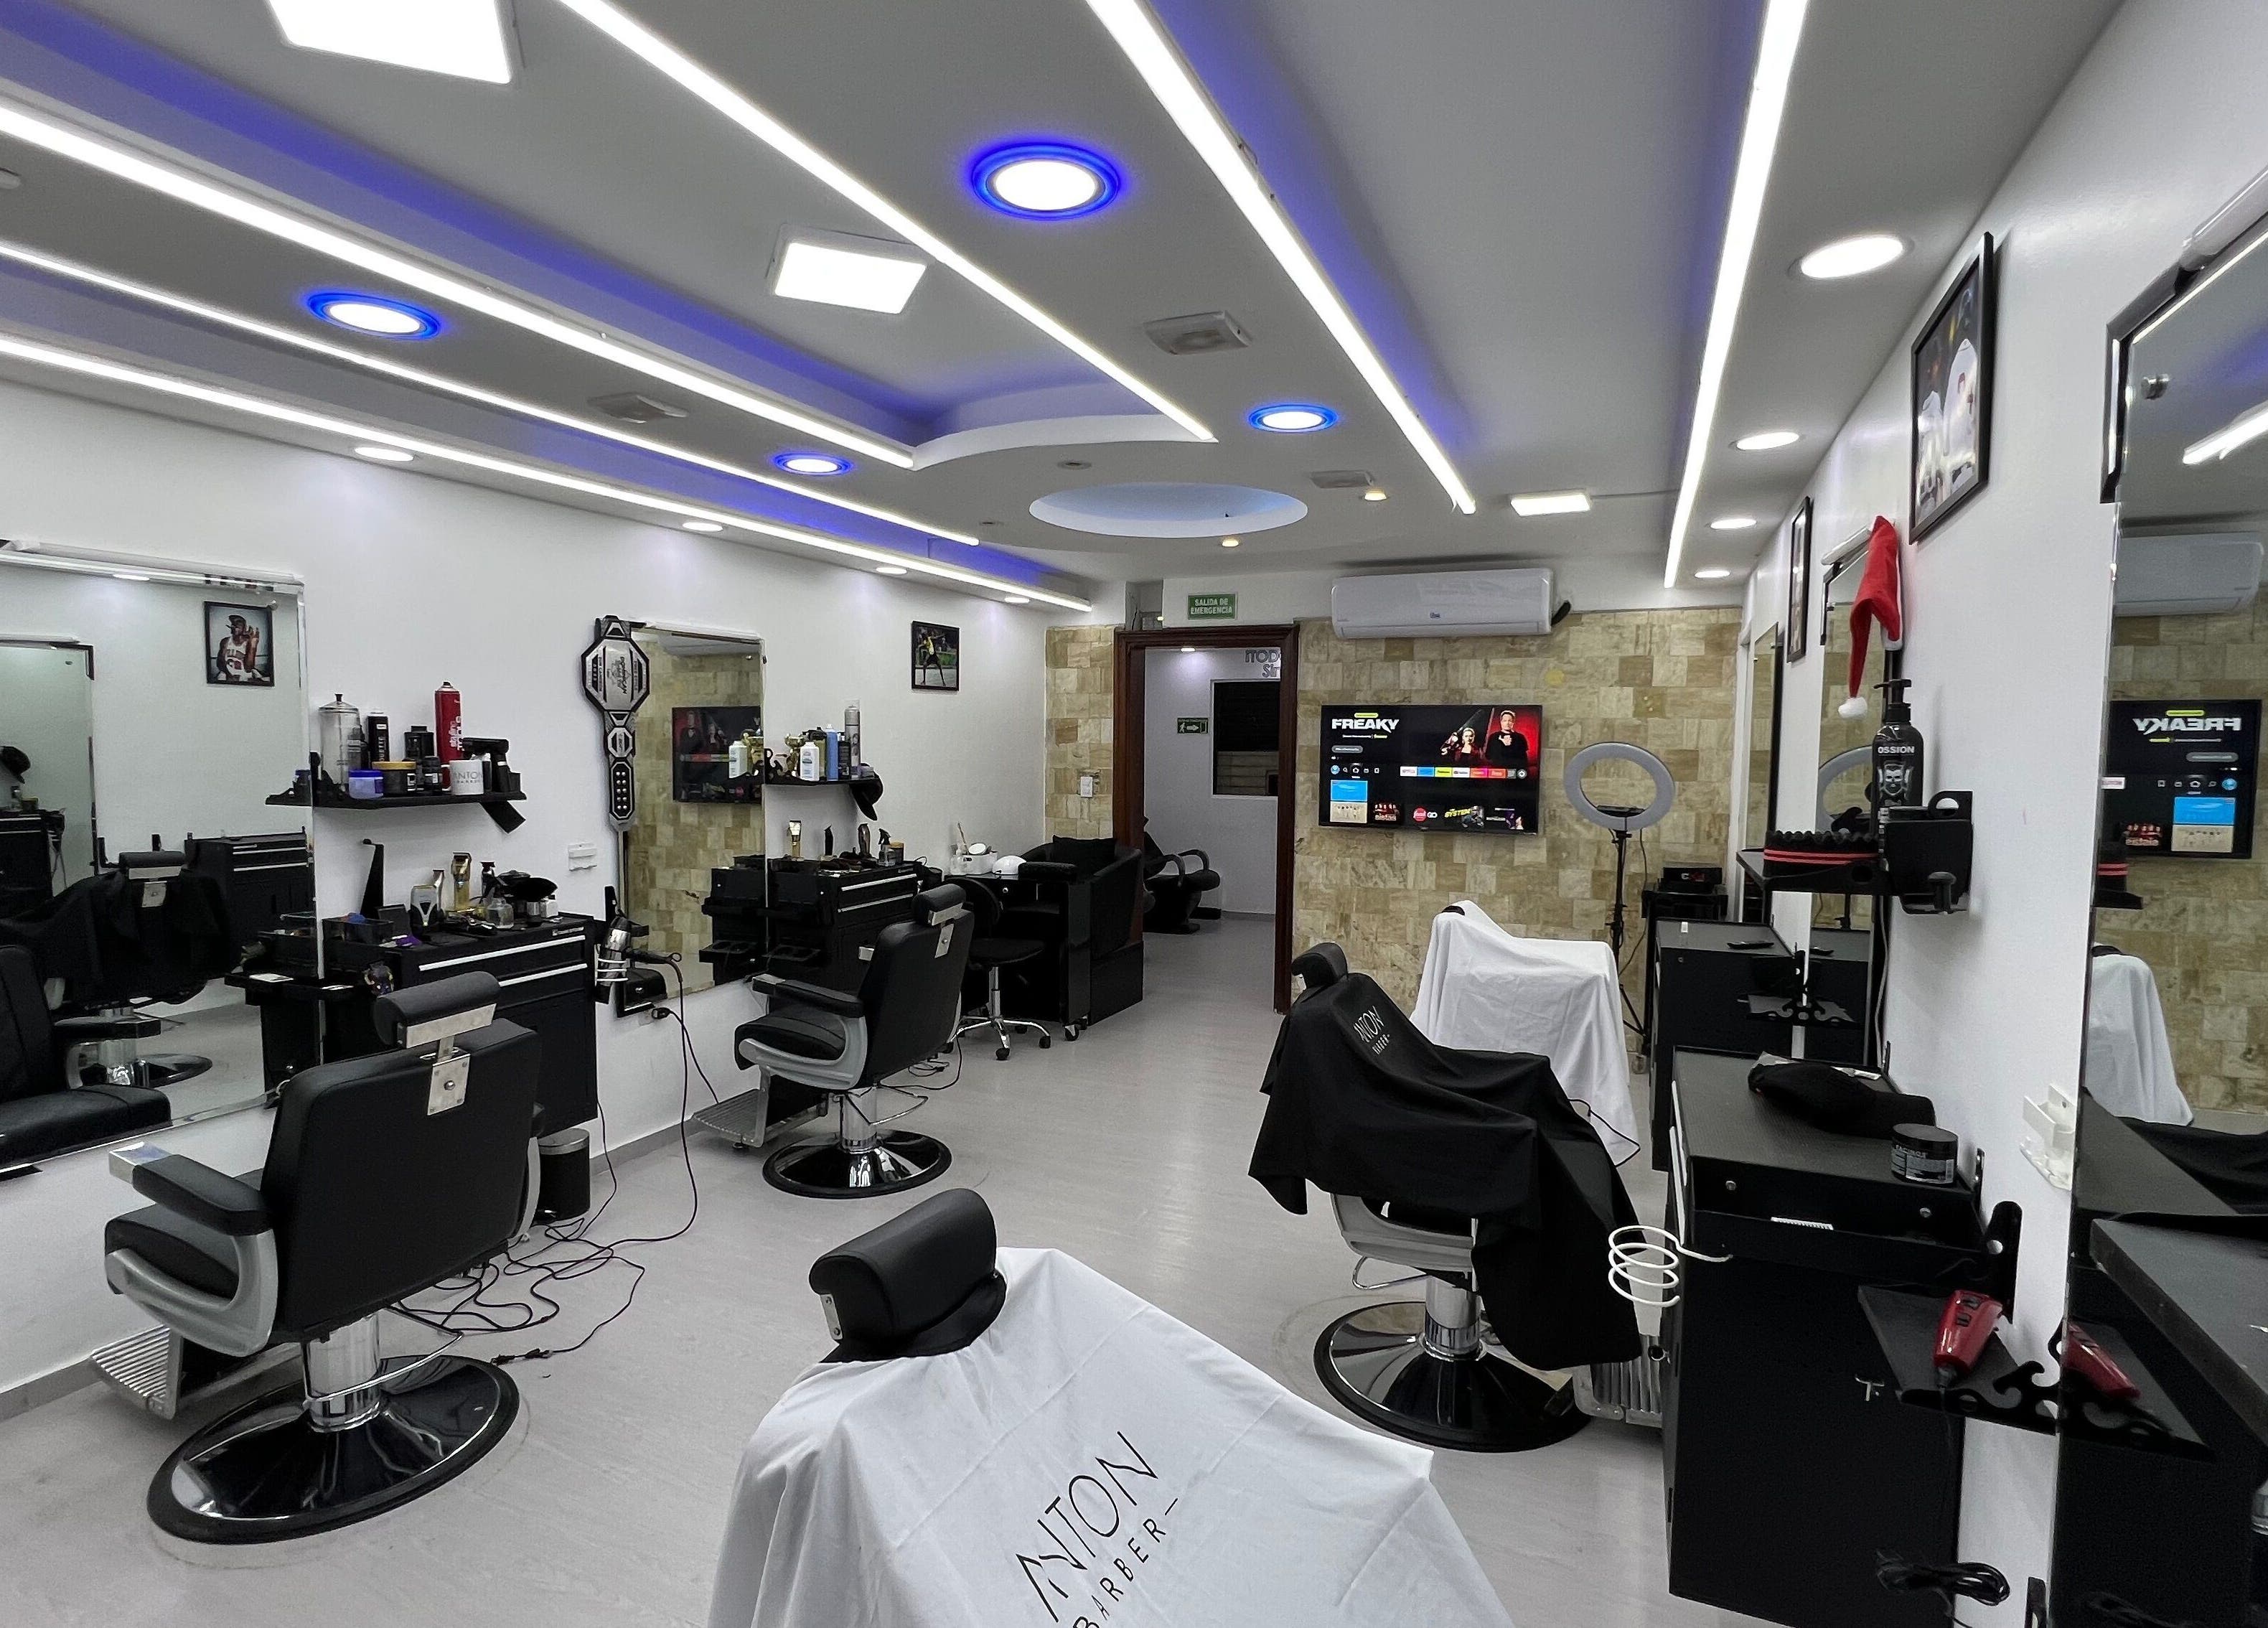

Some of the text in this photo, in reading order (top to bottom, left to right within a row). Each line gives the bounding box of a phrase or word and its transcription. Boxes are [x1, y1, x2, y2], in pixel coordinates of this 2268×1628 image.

[1195, 598, 1218, 607] SALIDA
[1191, 606, 1233, 615] EMERGENCIA
[1331, 719, 1400, 733] FREAKY
[1016, 1431, 1158, 1622] ANTON
